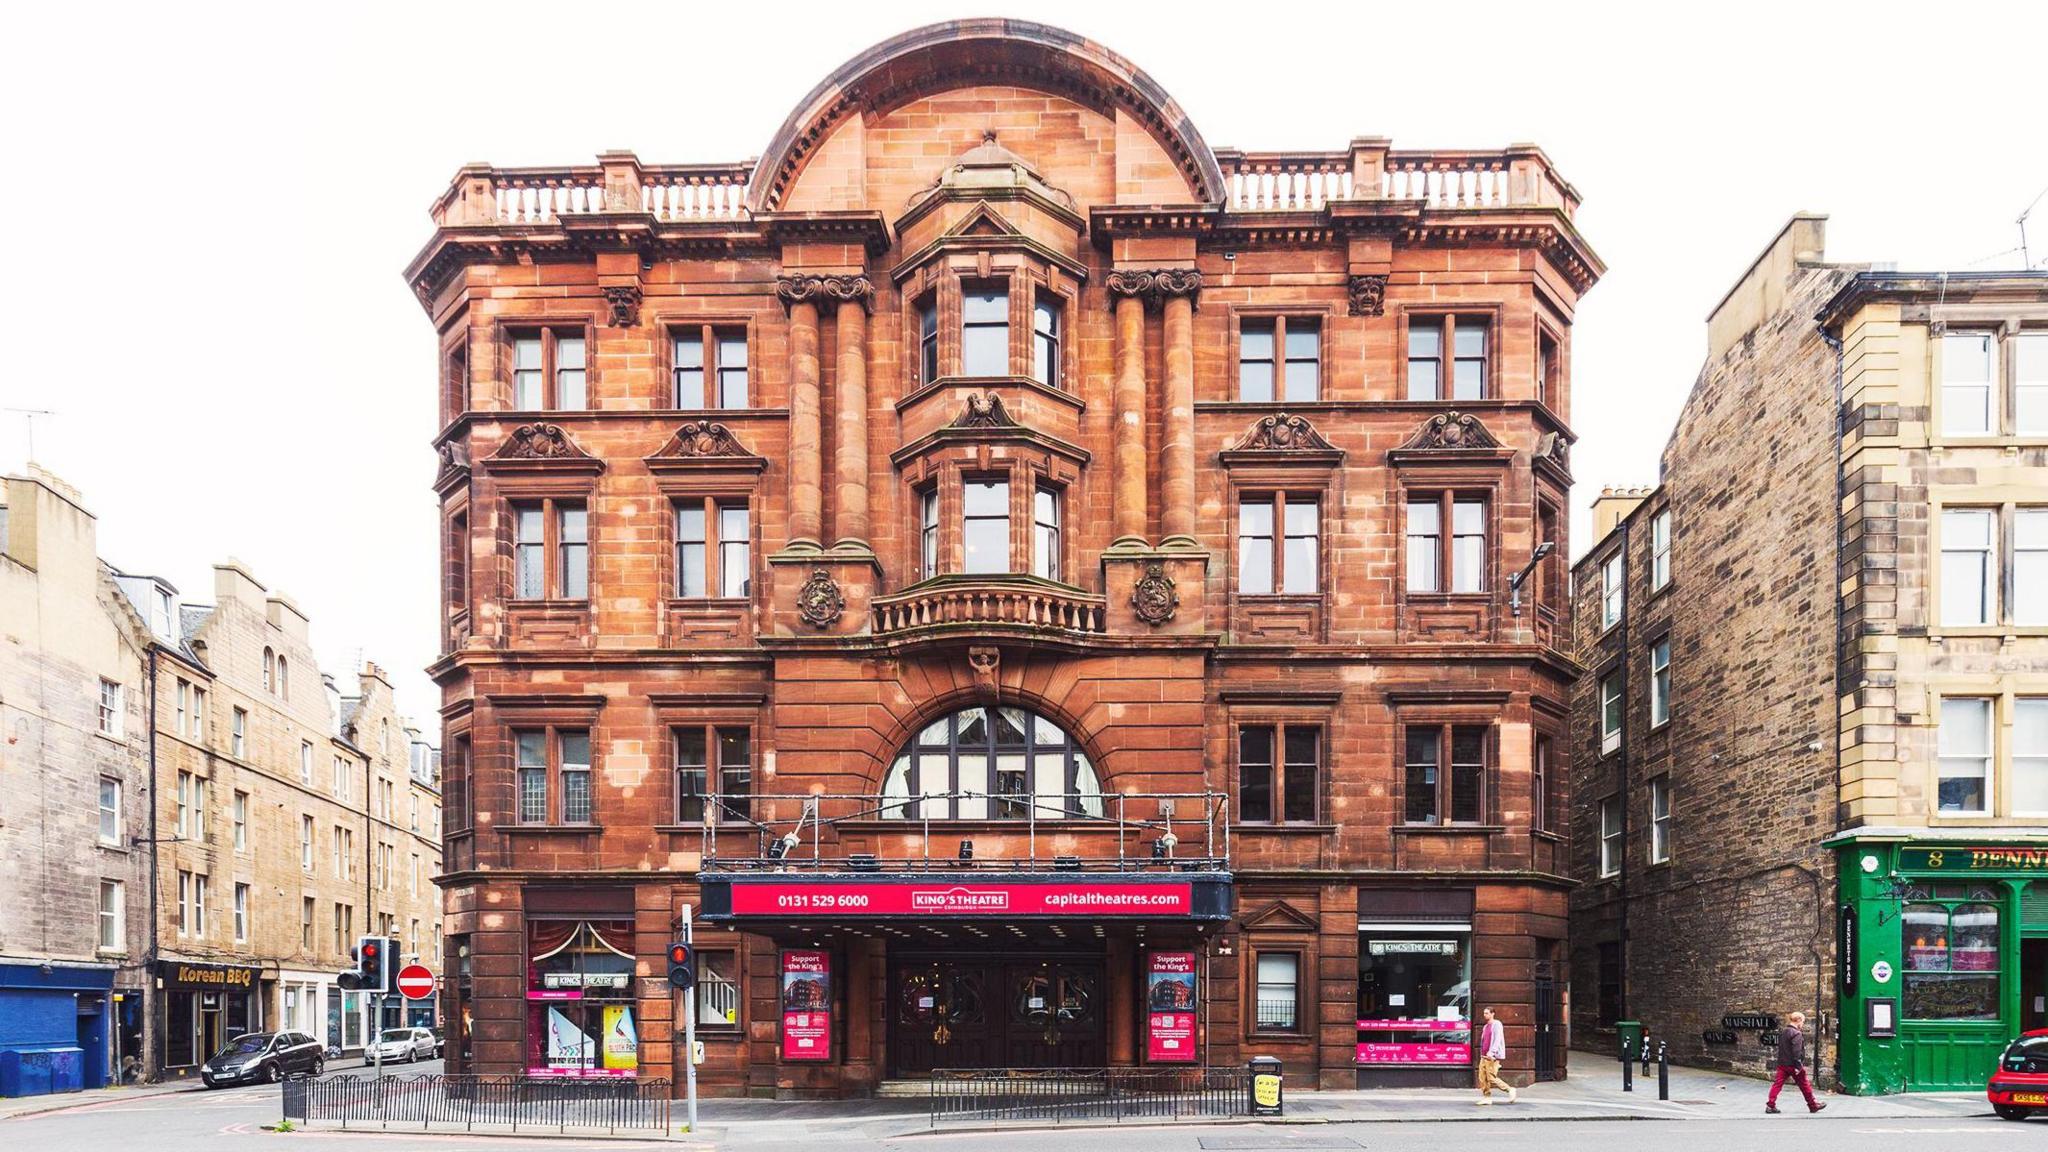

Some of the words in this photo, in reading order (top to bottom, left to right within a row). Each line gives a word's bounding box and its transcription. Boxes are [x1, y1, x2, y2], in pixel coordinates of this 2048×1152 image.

[1928, 850, 1944, 868] 8
[778, 895, 808, 907] 0131
[812, 895, 835, 907] 529
[838, 895, 869, 907] 6000
[916, 895, 956, 905] KING'S
[957, 895, 1004, 905] THEATRE
[1045, 892, 1180, 908] capitaltheatres.com
[791, 955, 820, 964] Support
[1156, 955, 1186, 964] Support
[802, 963, 823, 971] King's
[1167, 963, 1190, 971] King's
[178, 966, 225, 983] Korean
[226, 968, 252, 987] BBQ
